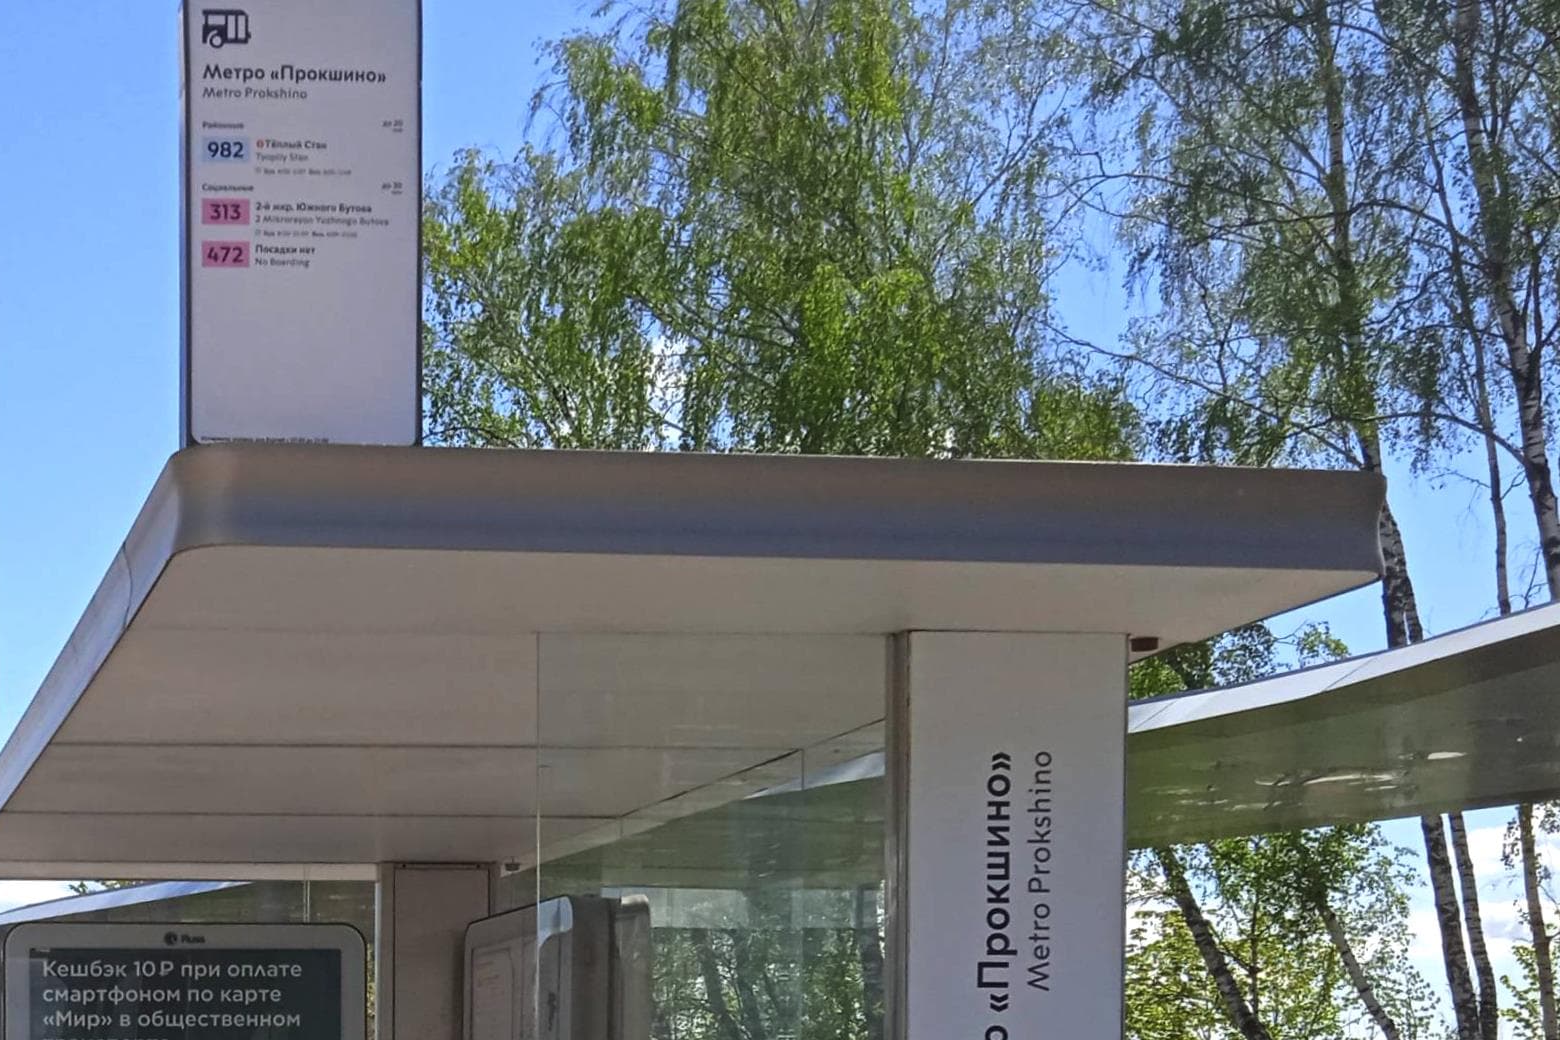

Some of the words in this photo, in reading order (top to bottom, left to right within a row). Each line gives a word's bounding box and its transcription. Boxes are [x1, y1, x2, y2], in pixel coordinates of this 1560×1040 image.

[202, 64, 266, 84] Метро
[270, 64, 387, 84] «Прокшино»
[202, 87, 242, 99] Metro
[244, 87, 308, 100] Prokshino
[207, 141, 244, 159] 982
[265, 139, 303, 151] Тёплый
[304, 141, 328, 150] Стан
[209, 203, 241, 221] 313
[296, 202, 337, 213] Южного
[339, 203, 373, 214] Бутова
[207, 247, 244, 264] 472
[255, 244, 298, 256] Посадки
[299, 247, 316, 255] нет
[255, 257, 268, 266] No
[1027, 750, 1053, 894] Prokshino
[976, 751, 1018, 1014] «Прокшино»
[1027, 902, 1051, 992] Metro
[42, 959, 127, 978] Кешбэк
[180, 962, 221, 980] при
[226, 962, 303, 978] оплате
[42, 985, 181, 1006] смартфоном
[187, 988, 214, 1002] по
[220, 988, 282, 1006] карте
[42, 1010, 113, 1030] «Мир»
[119, 1014, 132, 1027] в
[137, 1010, 301, 1030] общественном
